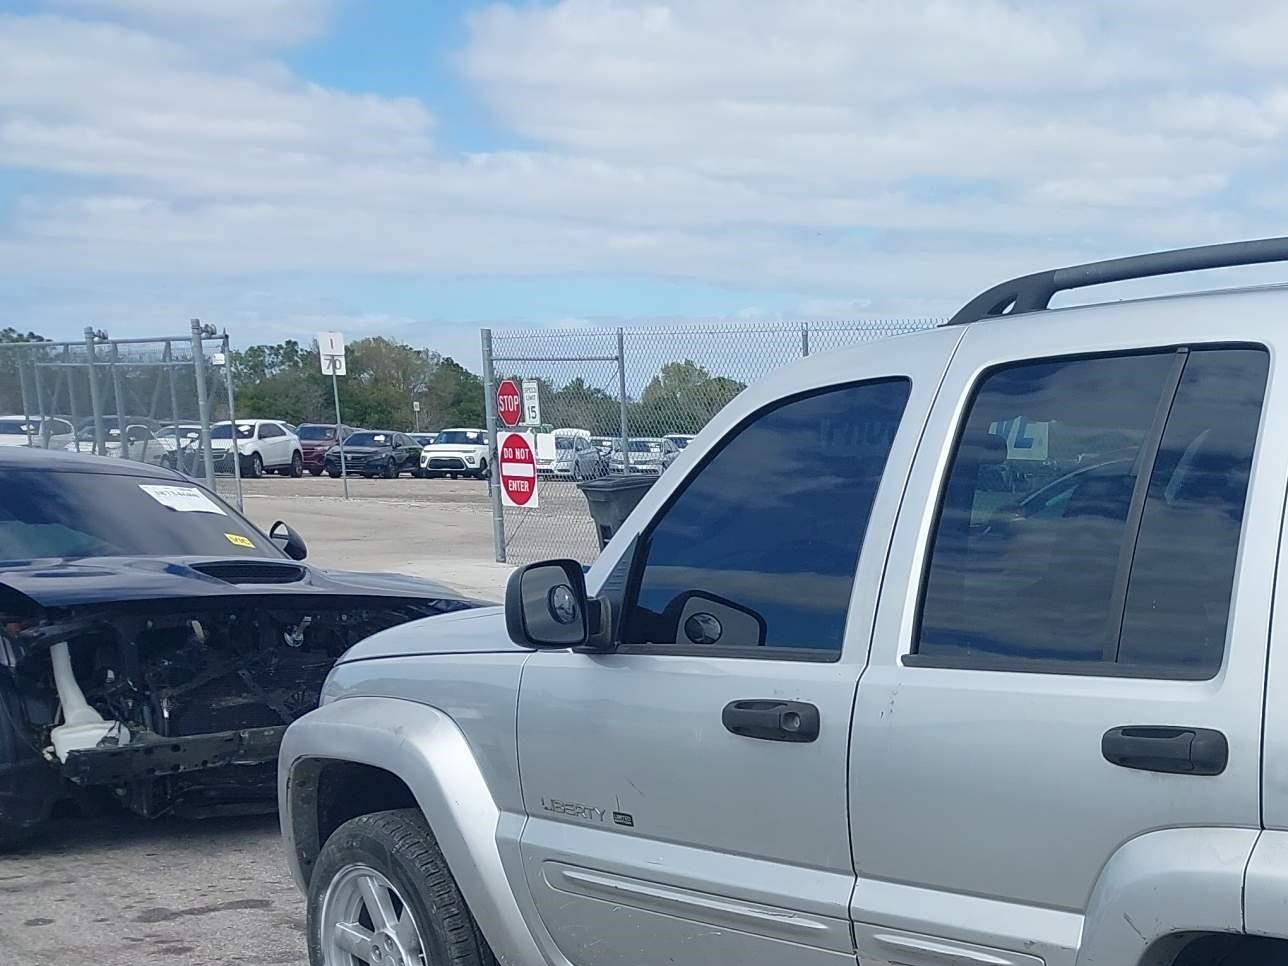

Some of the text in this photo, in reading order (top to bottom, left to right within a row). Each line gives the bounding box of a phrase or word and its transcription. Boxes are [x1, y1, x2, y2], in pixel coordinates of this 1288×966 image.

[499, 395, 519, 412] STOP
[527, 405, 537, 420] 15
[503, 447, 529, 460] DO NOT
[508, 479, 529, 492] ENTER
[541, 797, 606, 822] LIBERTY
